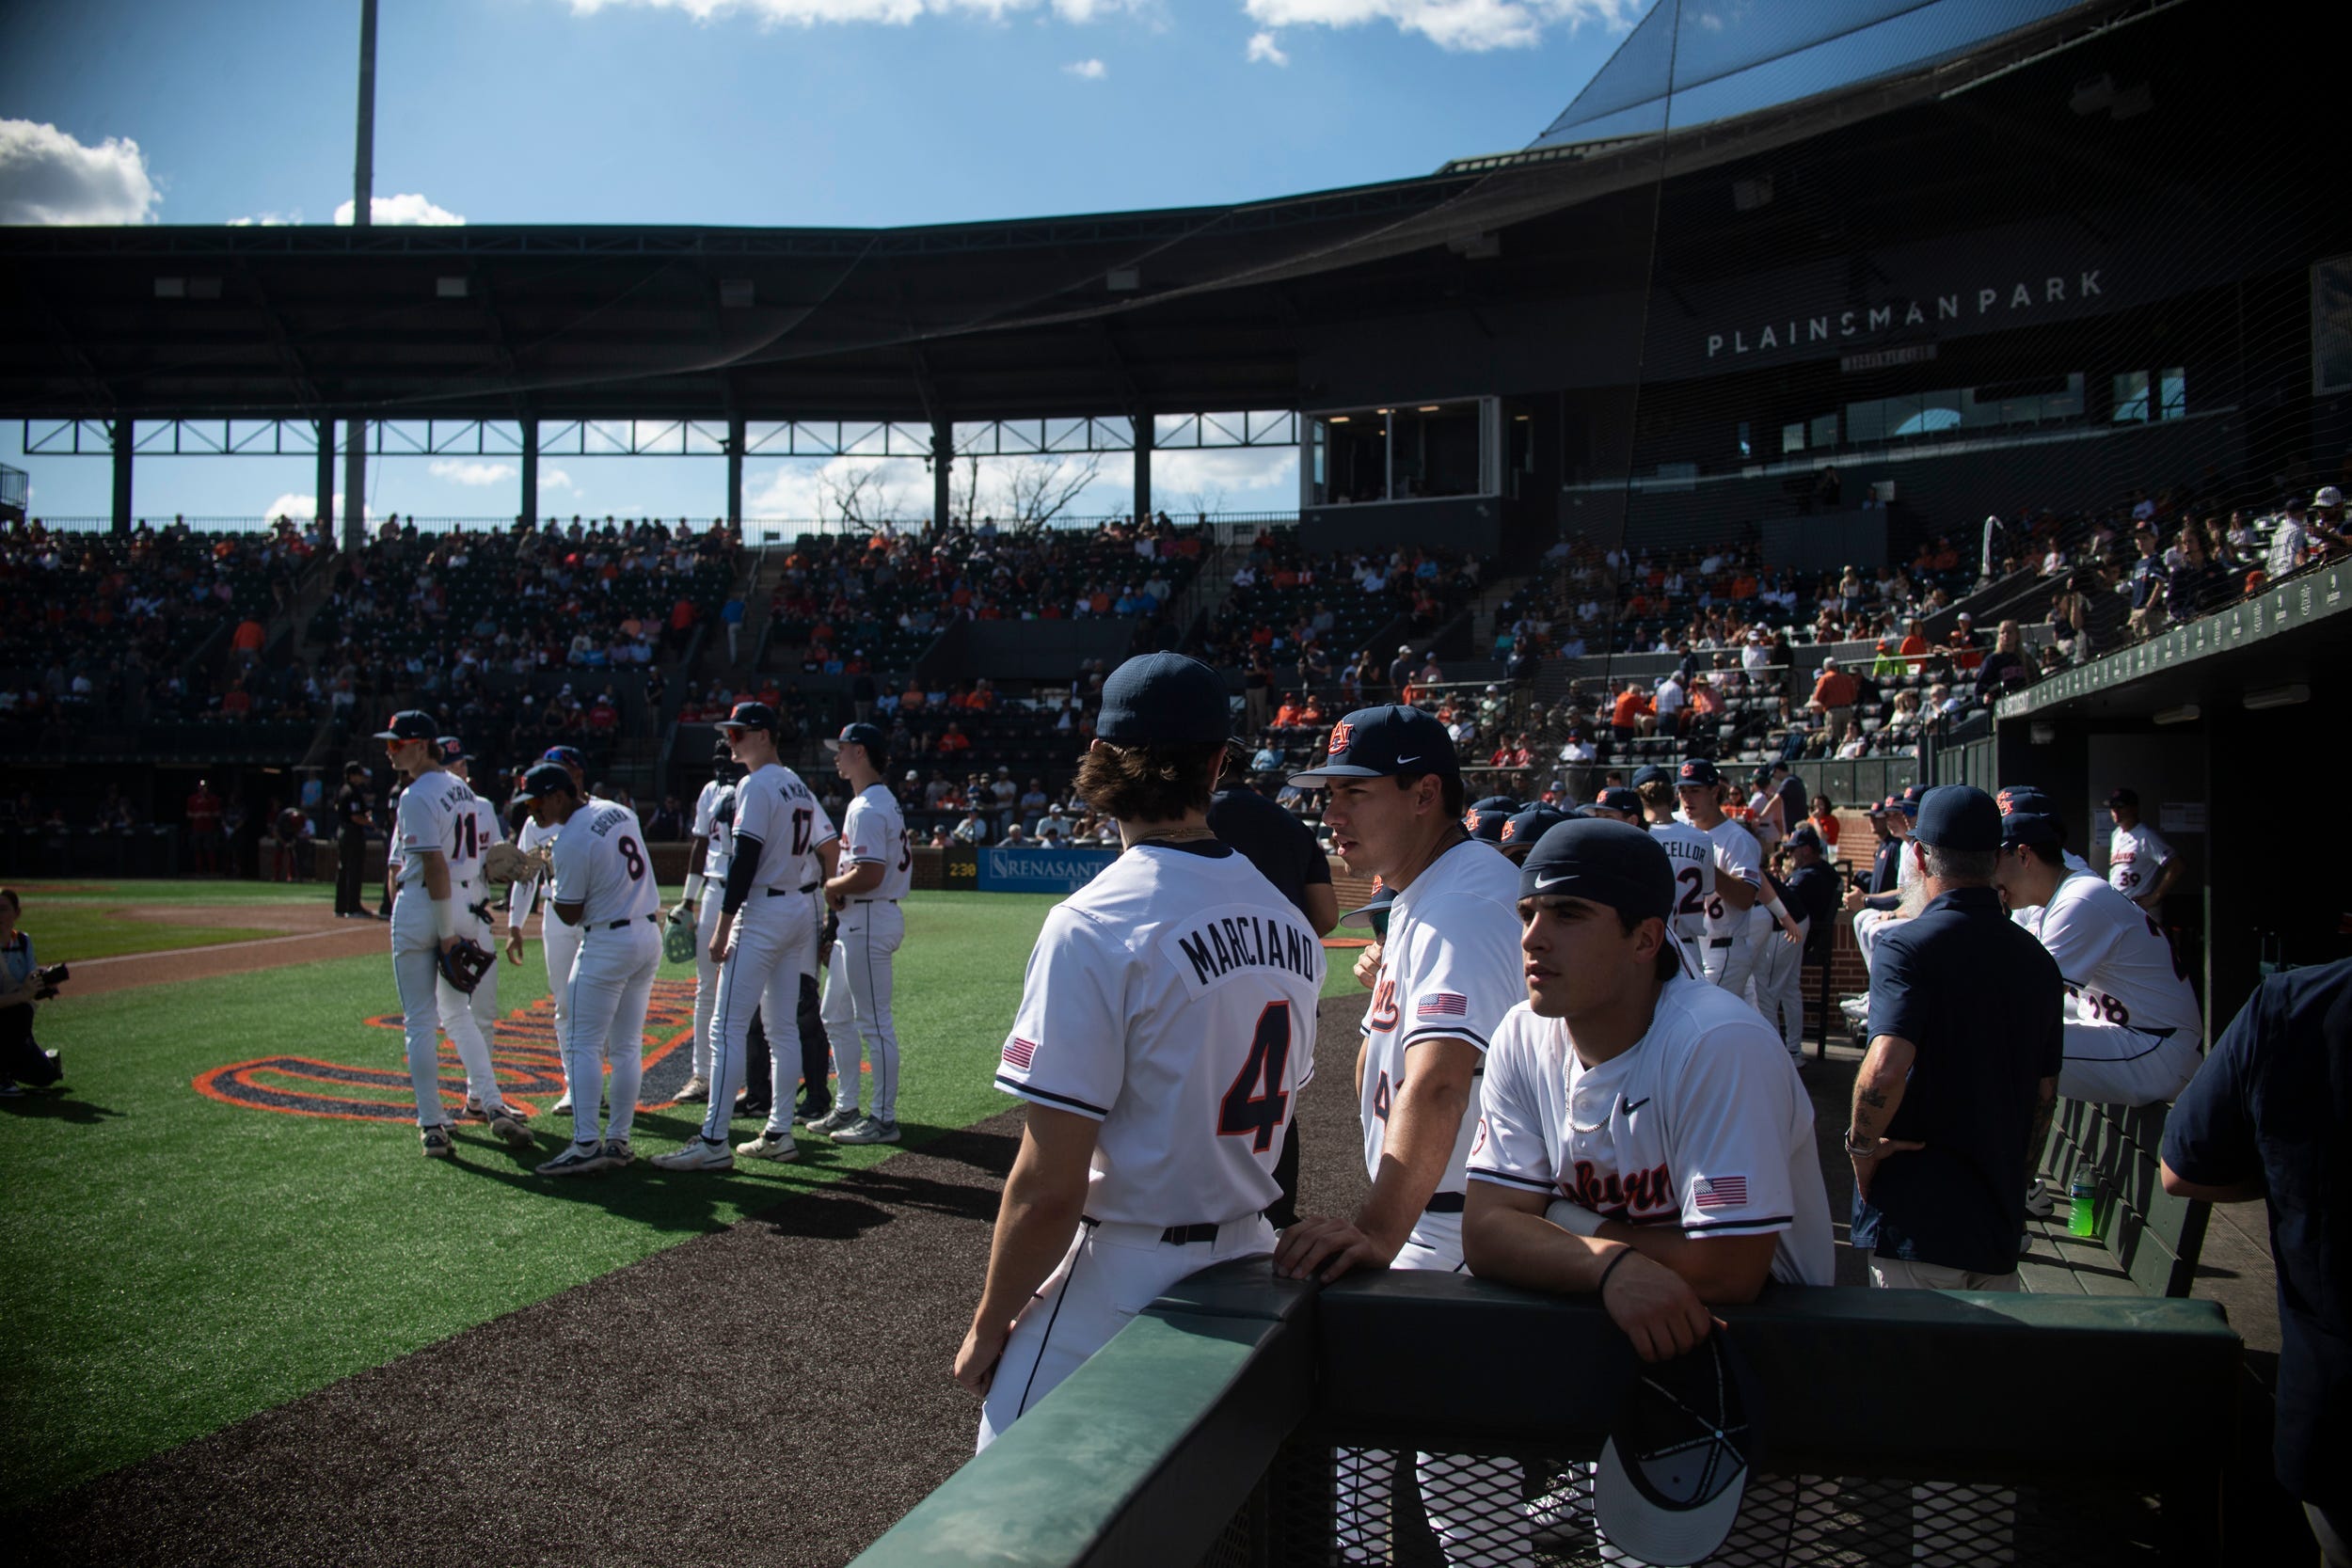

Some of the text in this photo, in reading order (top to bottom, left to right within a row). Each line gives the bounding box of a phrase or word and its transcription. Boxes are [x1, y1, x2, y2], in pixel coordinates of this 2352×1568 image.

[1707, 293, 1960, 358] PLAINSMAN
[1978, 270, 2102, 314] PARK
[452, 812, 478, 860] 11
[791, 806, 815, 857] 17
[618, 835, 645, 881] 8
[1008, 860, 1104, 878] RENASANT
[2120, 872, 2141, 887] 39
[1674, 866, 1704, 918] 2
[1178, 916, 1314, 986] MARCIANO
[1216, 1000, 1292, 1155] 4
[1374, 1069, 1406, 1130] 4
